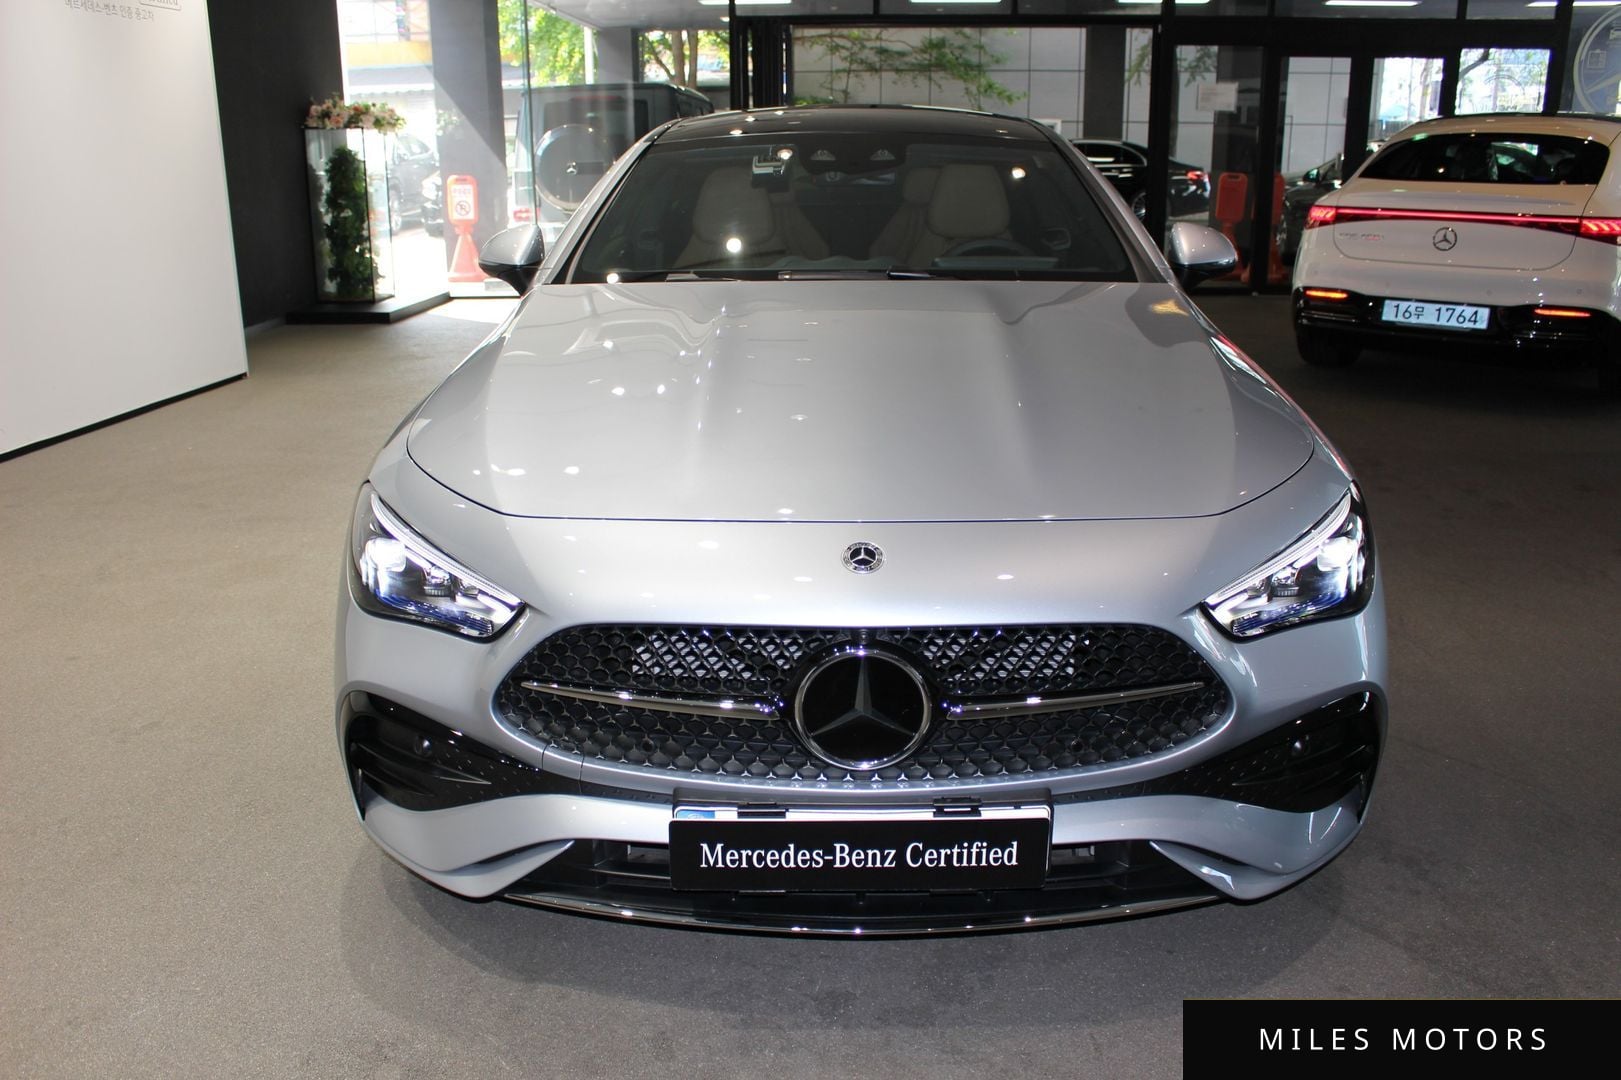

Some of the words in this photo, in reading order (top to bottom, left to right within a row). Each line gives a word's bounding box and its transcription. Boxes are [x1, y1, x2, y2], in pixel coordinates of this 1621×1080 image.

[1394, 303, 1424, 320] 16무
[1435, 307, 1479, 325] 1764
[700, 843, 896, 869] Mercedes-Benz
[906, 841, 1018, 867] Certified
